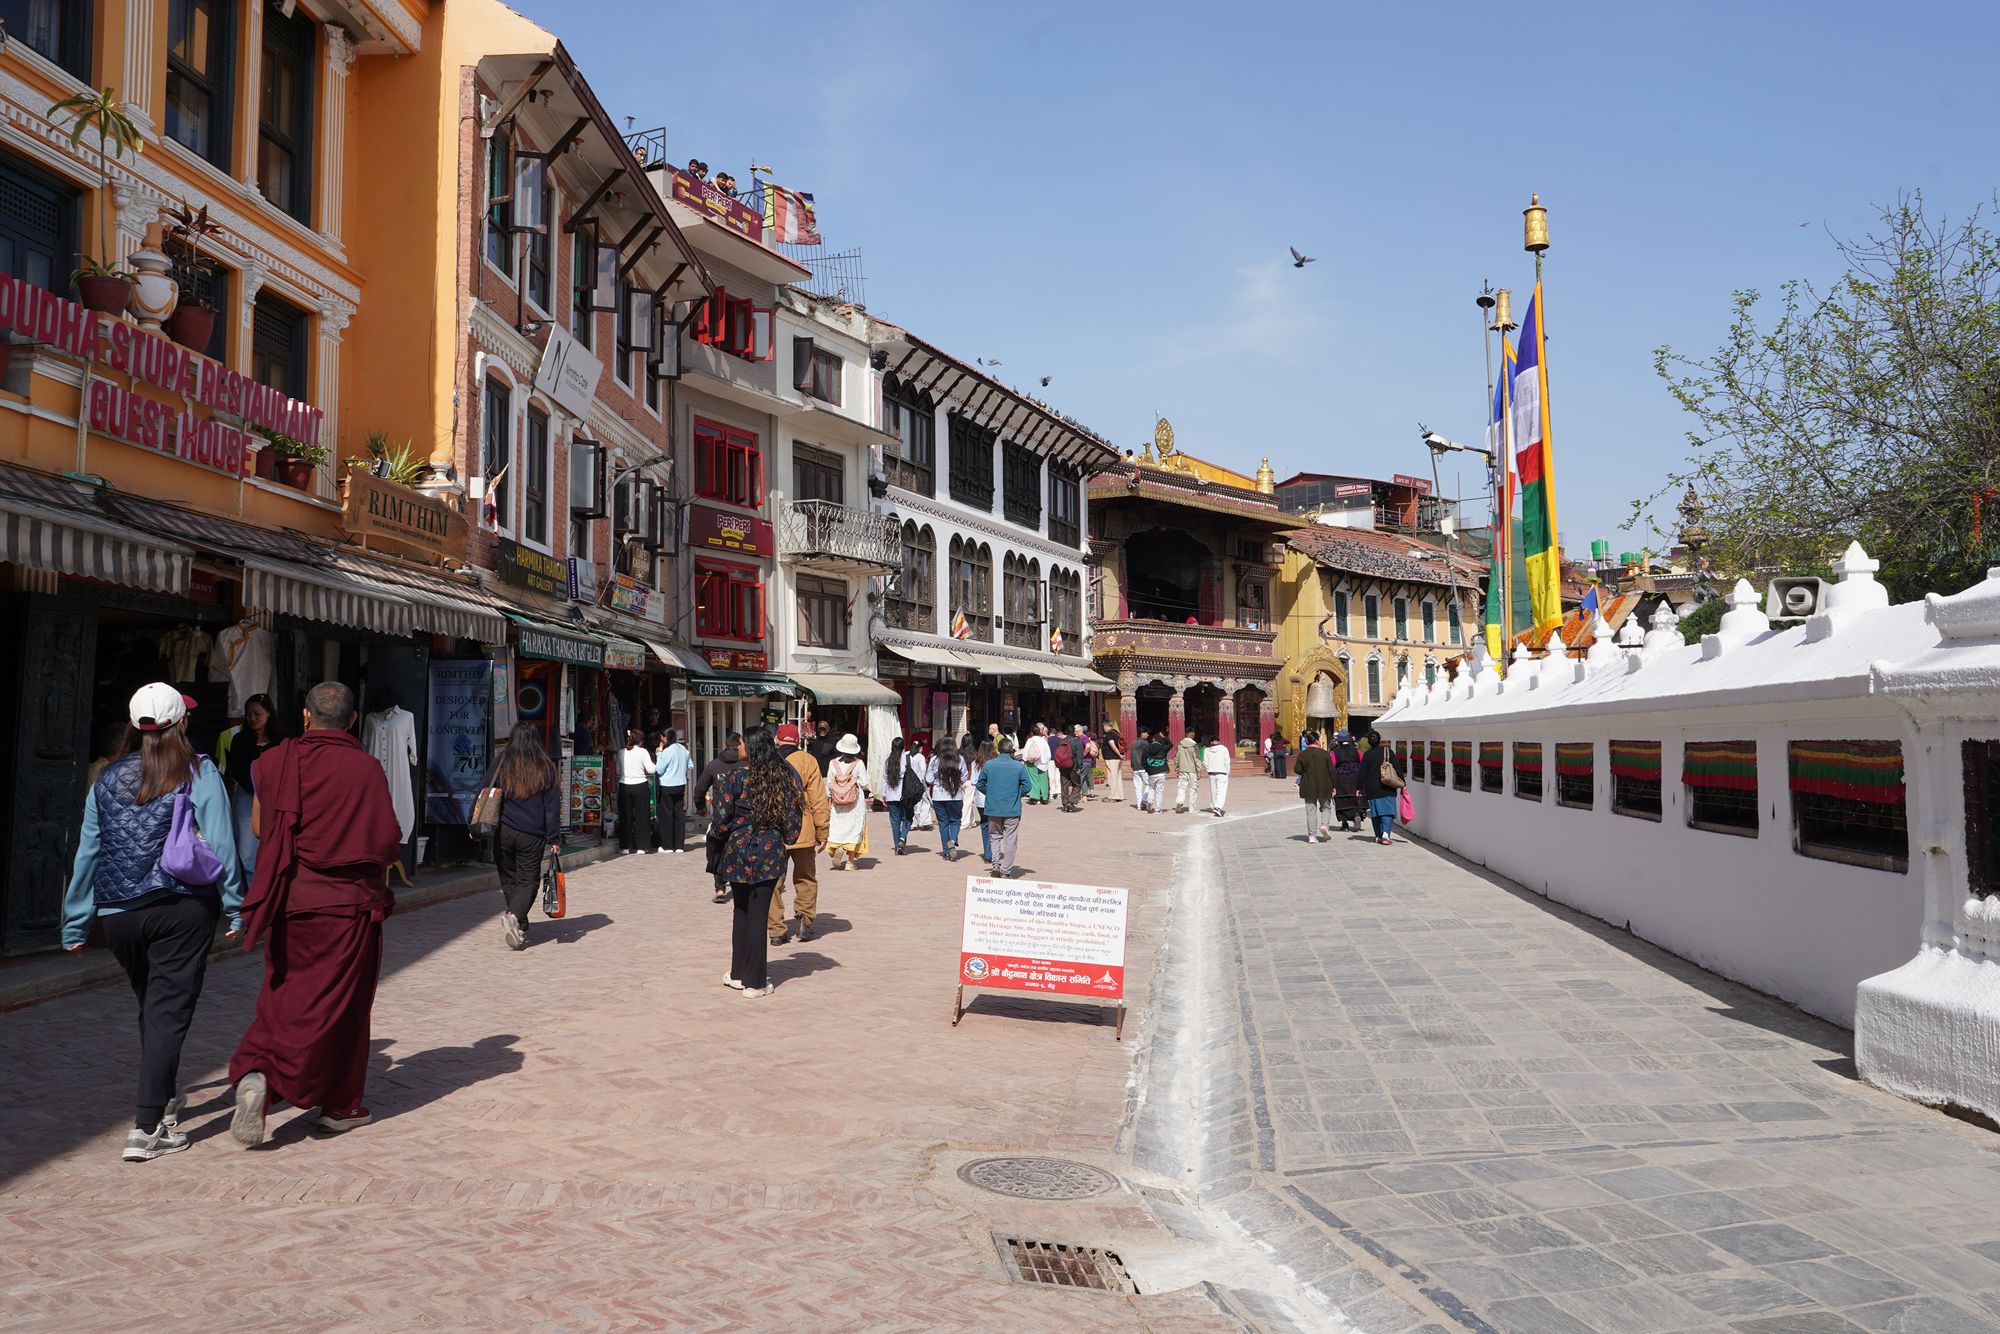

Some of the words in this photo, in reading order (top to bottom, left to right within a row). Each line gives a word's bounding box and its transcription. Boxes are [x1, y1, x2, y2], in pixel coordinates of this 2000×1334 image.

[109, 321, 193, 397] STUPA
[199, 357, 324, 447] RESTAURANT
[89, 379, 175, 452] GUEST
[179, 411, 253, 478] HOUSE
[368, 488, 449, 537] RIMTHIM
[516, 546, 543, 573] HARMIKA
[543, 556, 567, 584] THANGKA
[527, 573, 536, 587] ART
[536, 576, 554, 592] GALLERY
[699, 683, 731, 696] COFFEE
[435, 696, 486, 705] DESIGNED
[450, 711, 469, 720] FOR
[459, 756, 479, 773] 70
[988, 922, 1013, 930] Heritage
[991, 967, 1000, 977] श्री
[1044, 971, 1067, 983] विकास
[1069, 974, 1091, 985] समिति
